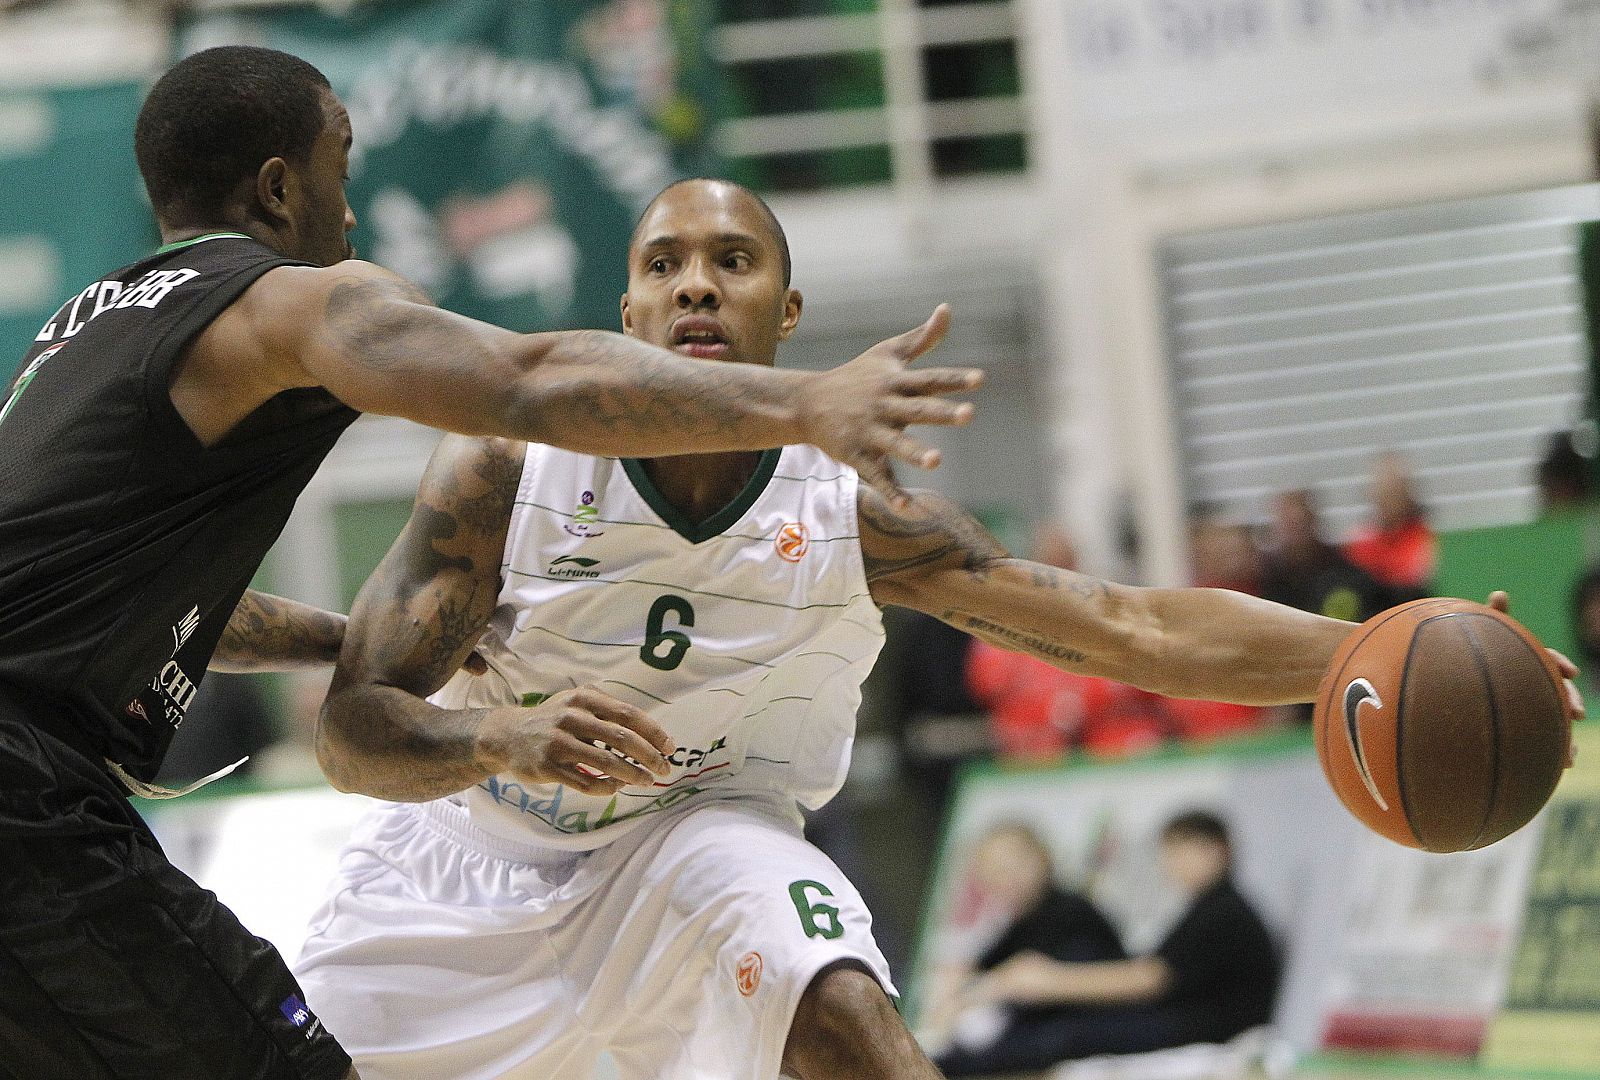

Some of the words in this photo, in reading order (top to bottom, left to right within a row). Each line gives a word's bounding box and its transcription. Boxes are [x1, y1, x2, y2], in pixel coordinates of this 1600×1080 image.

[640, 594, 696, 671] 6
[164, 699, 184, 730] 472
[788, 879, 845, 940] 6
